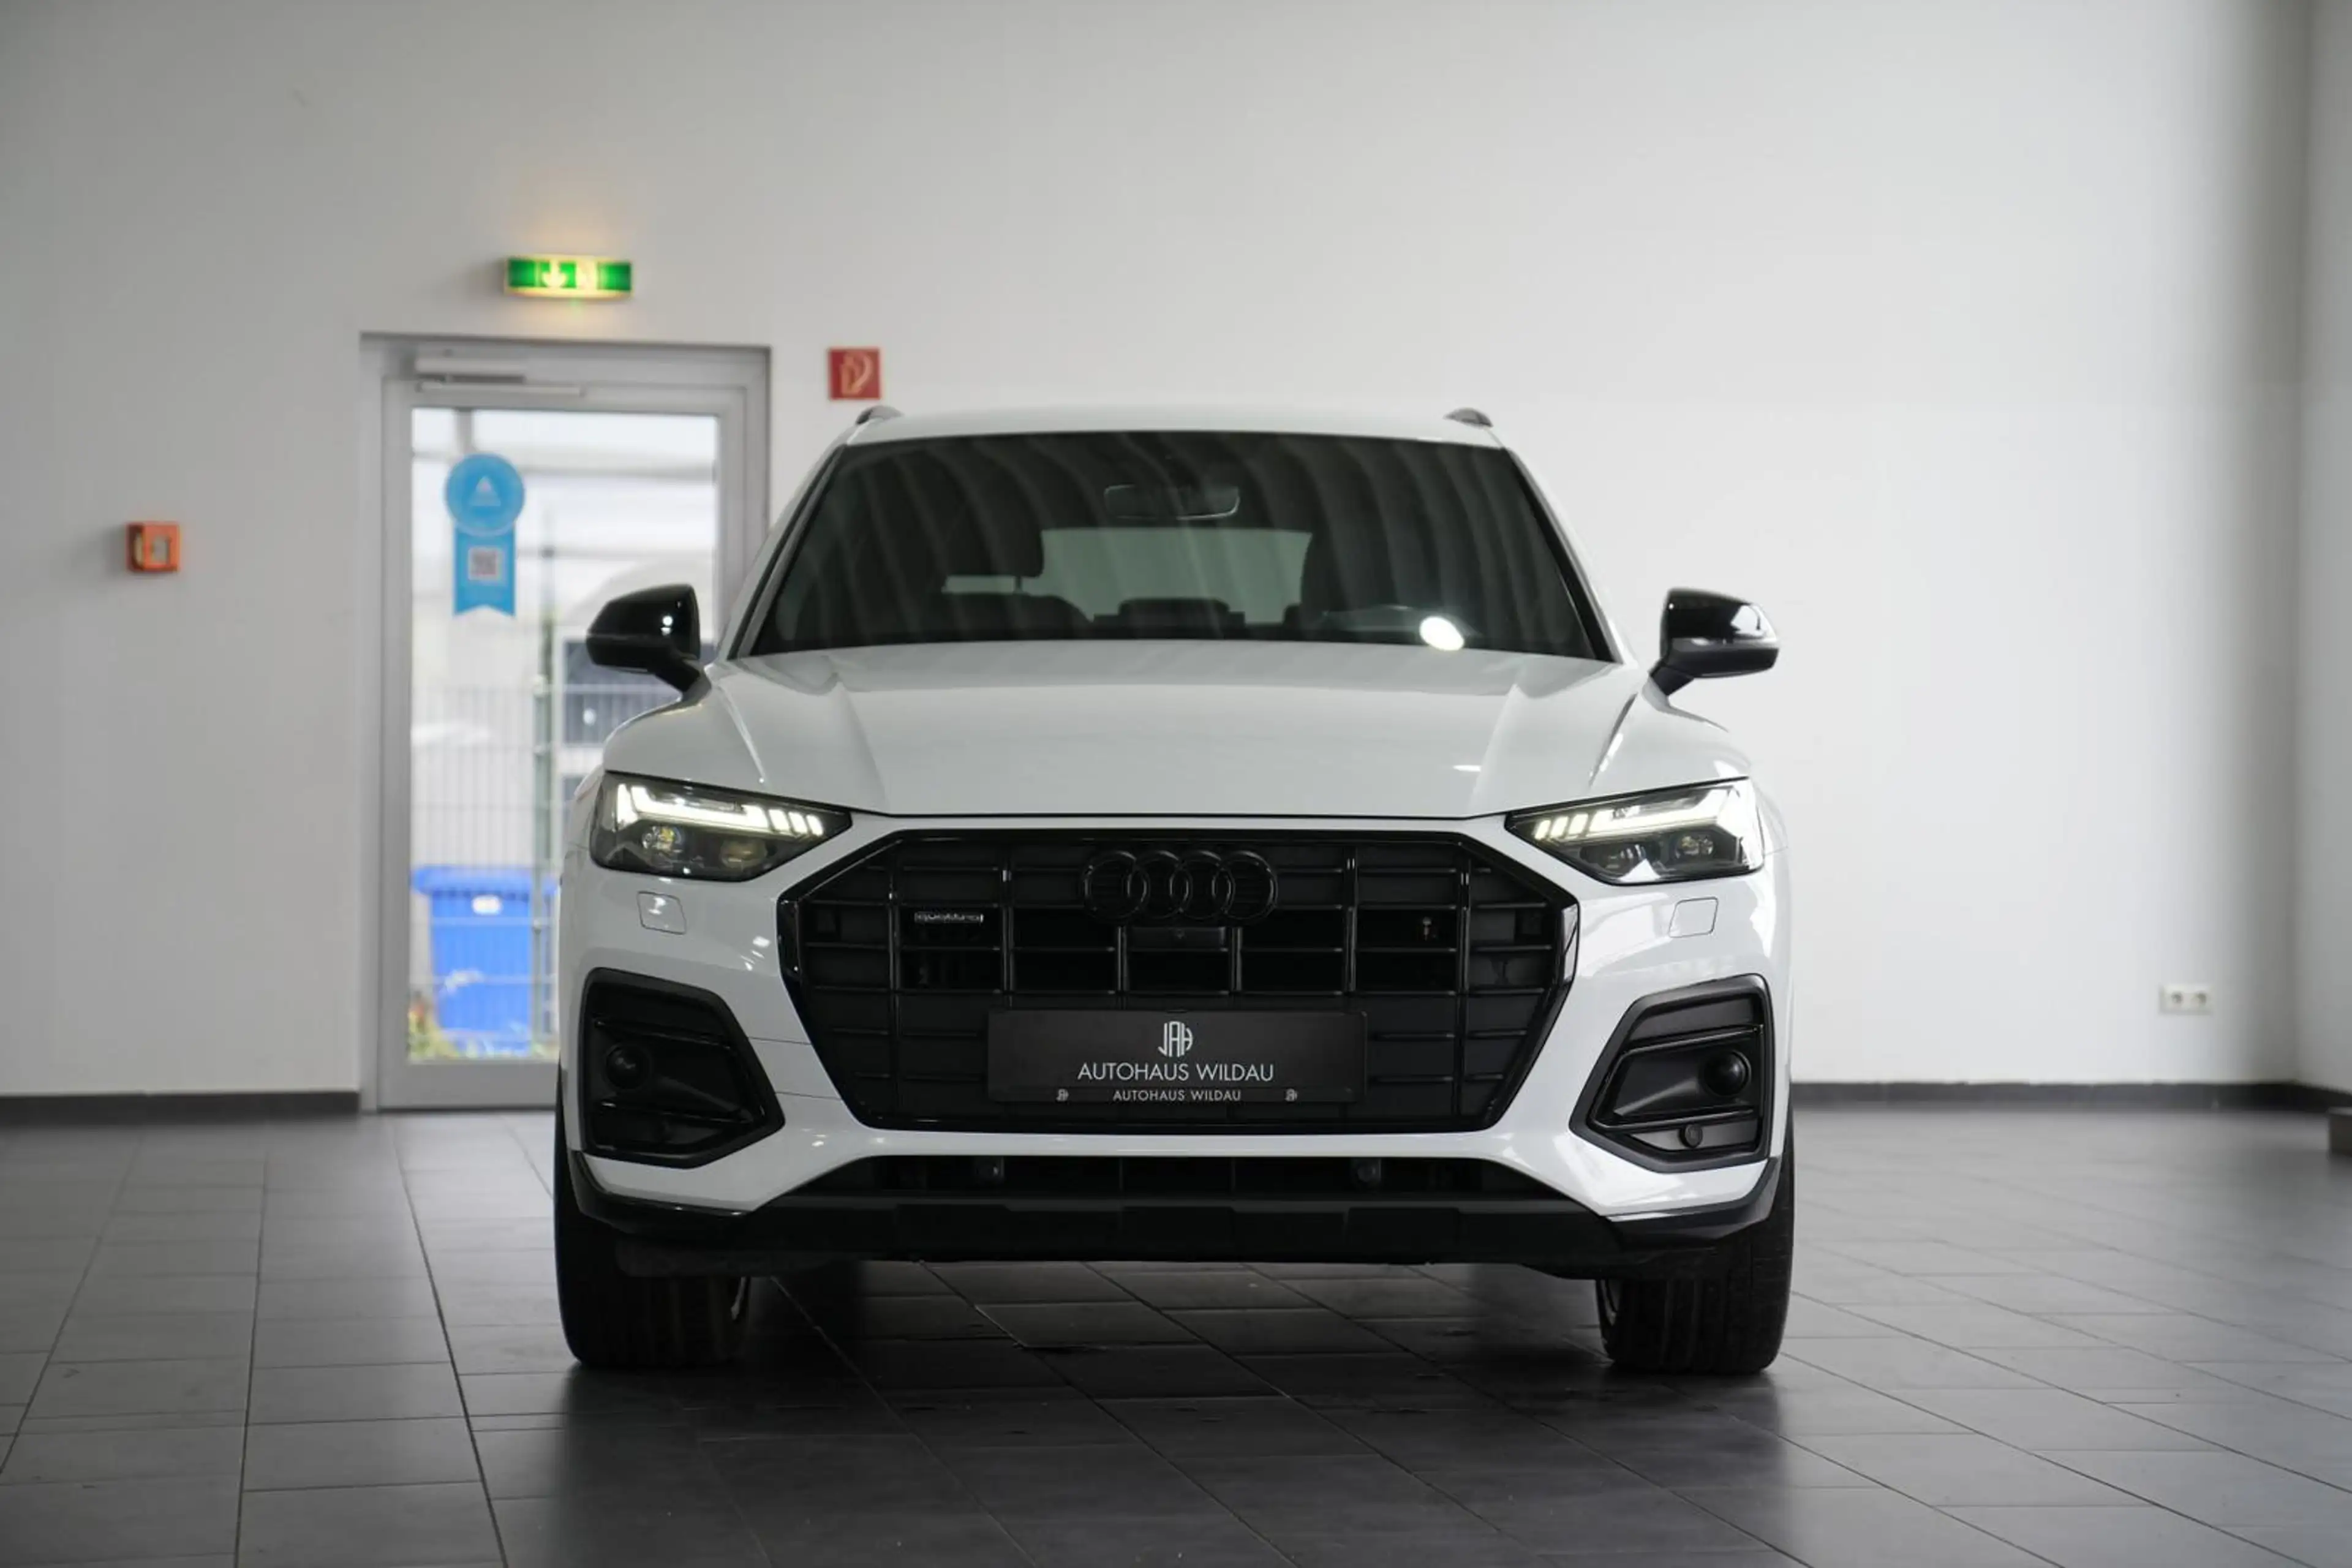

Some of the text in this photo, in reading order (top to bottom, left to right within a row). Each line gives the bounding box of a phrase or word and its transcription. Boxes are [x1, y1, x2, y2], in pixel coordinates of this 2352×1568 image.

[1077, 1062, 1274, 1082] AUTOHAUS WILDAU
[1113, 1089, 1242, 1102] AUTOHAUS WILDAU
